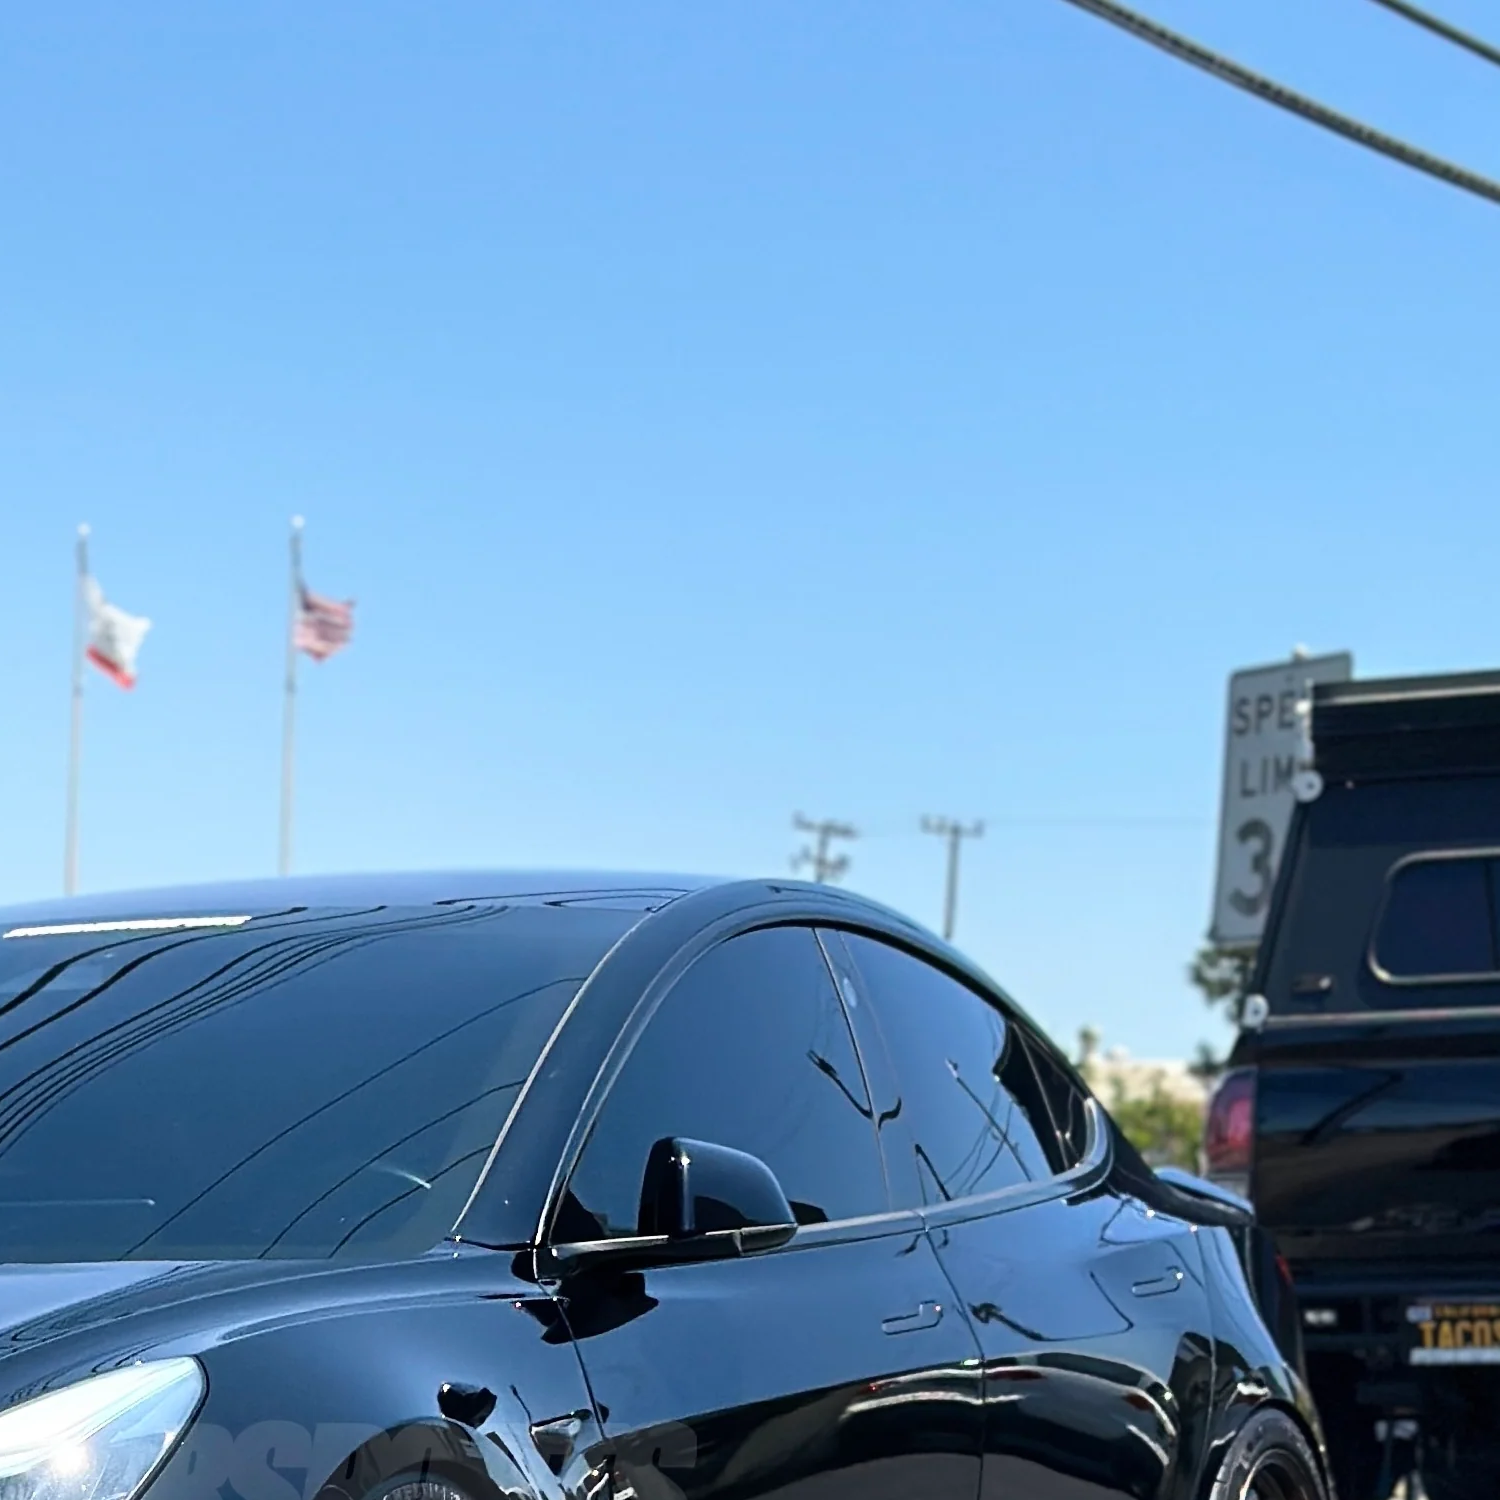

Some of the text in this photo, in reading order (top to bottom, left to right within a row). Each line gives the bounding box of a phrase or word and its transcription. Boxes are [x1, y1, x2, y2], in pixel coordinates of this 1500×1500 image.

[1231, 690, 1308, 736] SPE
[1239, 755, 1310, 798] LIM
[1228, 818, 1273, 917] 3
